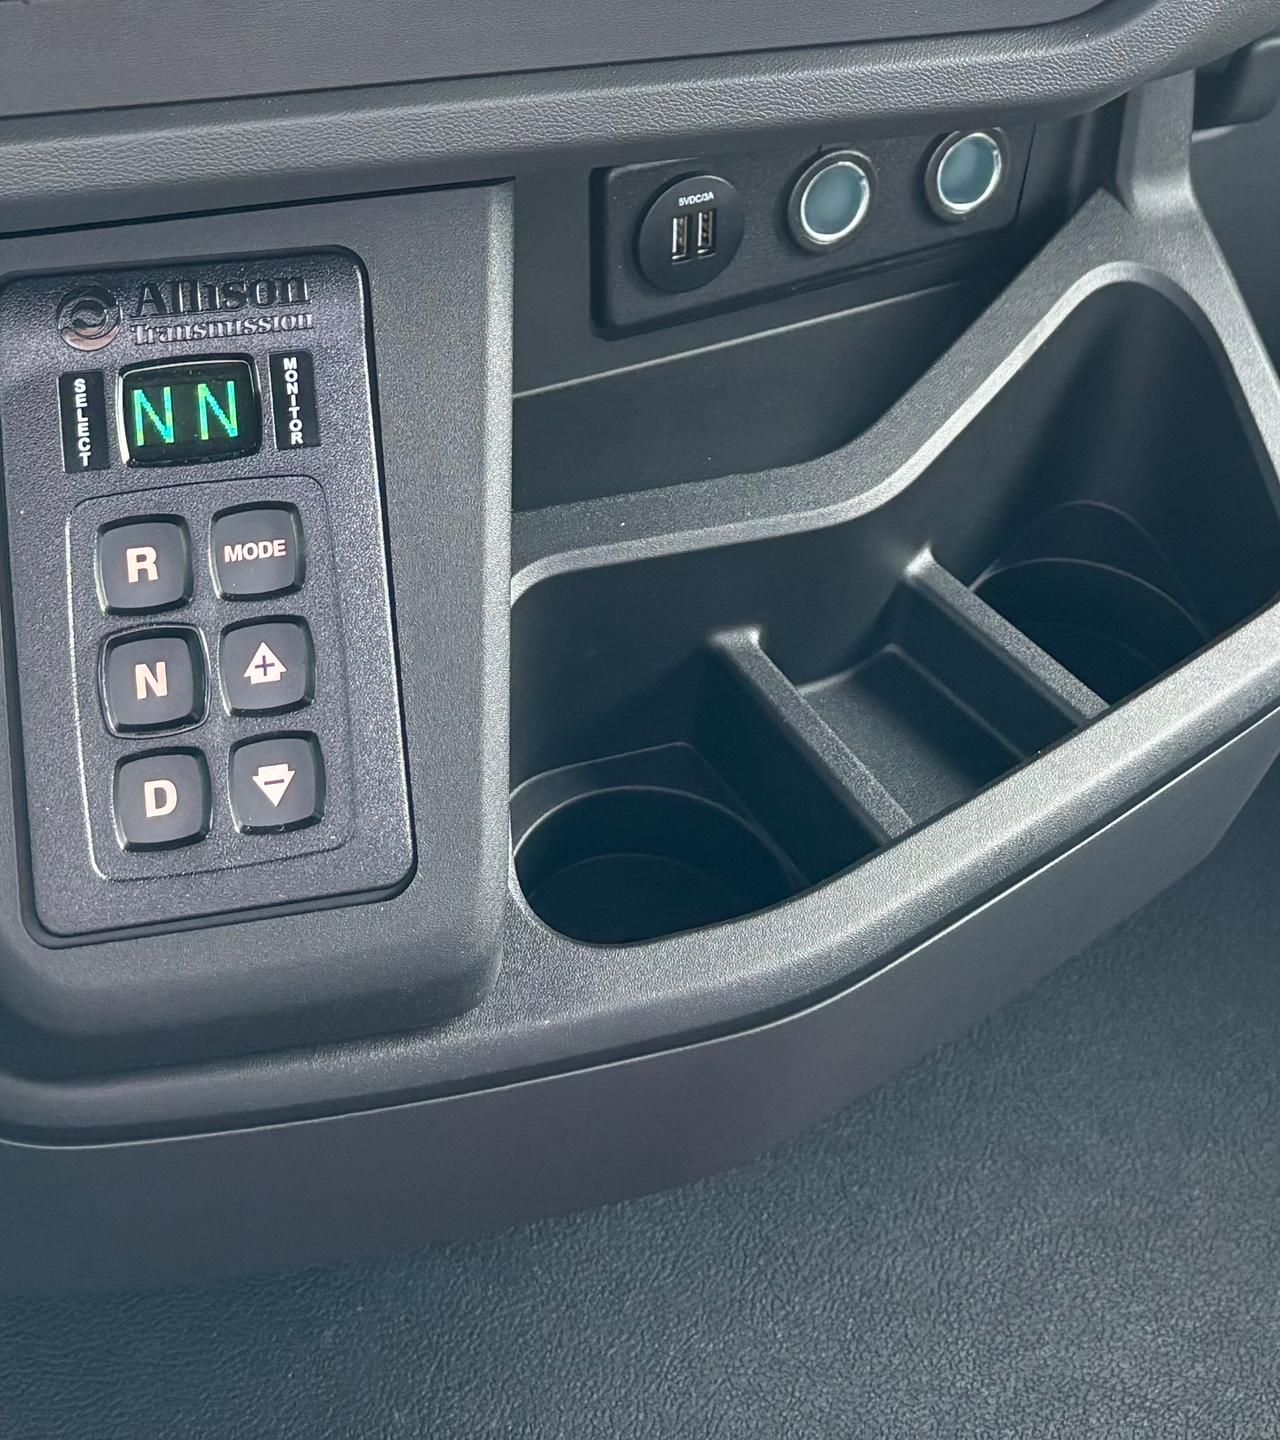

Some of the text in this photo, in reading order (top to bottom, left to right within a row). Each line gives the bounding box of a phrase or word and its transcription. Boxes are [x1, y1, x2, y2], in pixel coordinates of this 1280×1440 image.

[130, 277, 311, 318] Allison
[131, 313, 315, 346] Transmission
[133, 380, 239, 447] N N
[283, 357, 304, 445] MONITOR
[73, 377, 92, 467] SELECT
[126, 546, 159, 583] R
[224, 539, 287, 563] MODE
[135, 661, 168, 700] N
[144, 780, 178, 817] D
